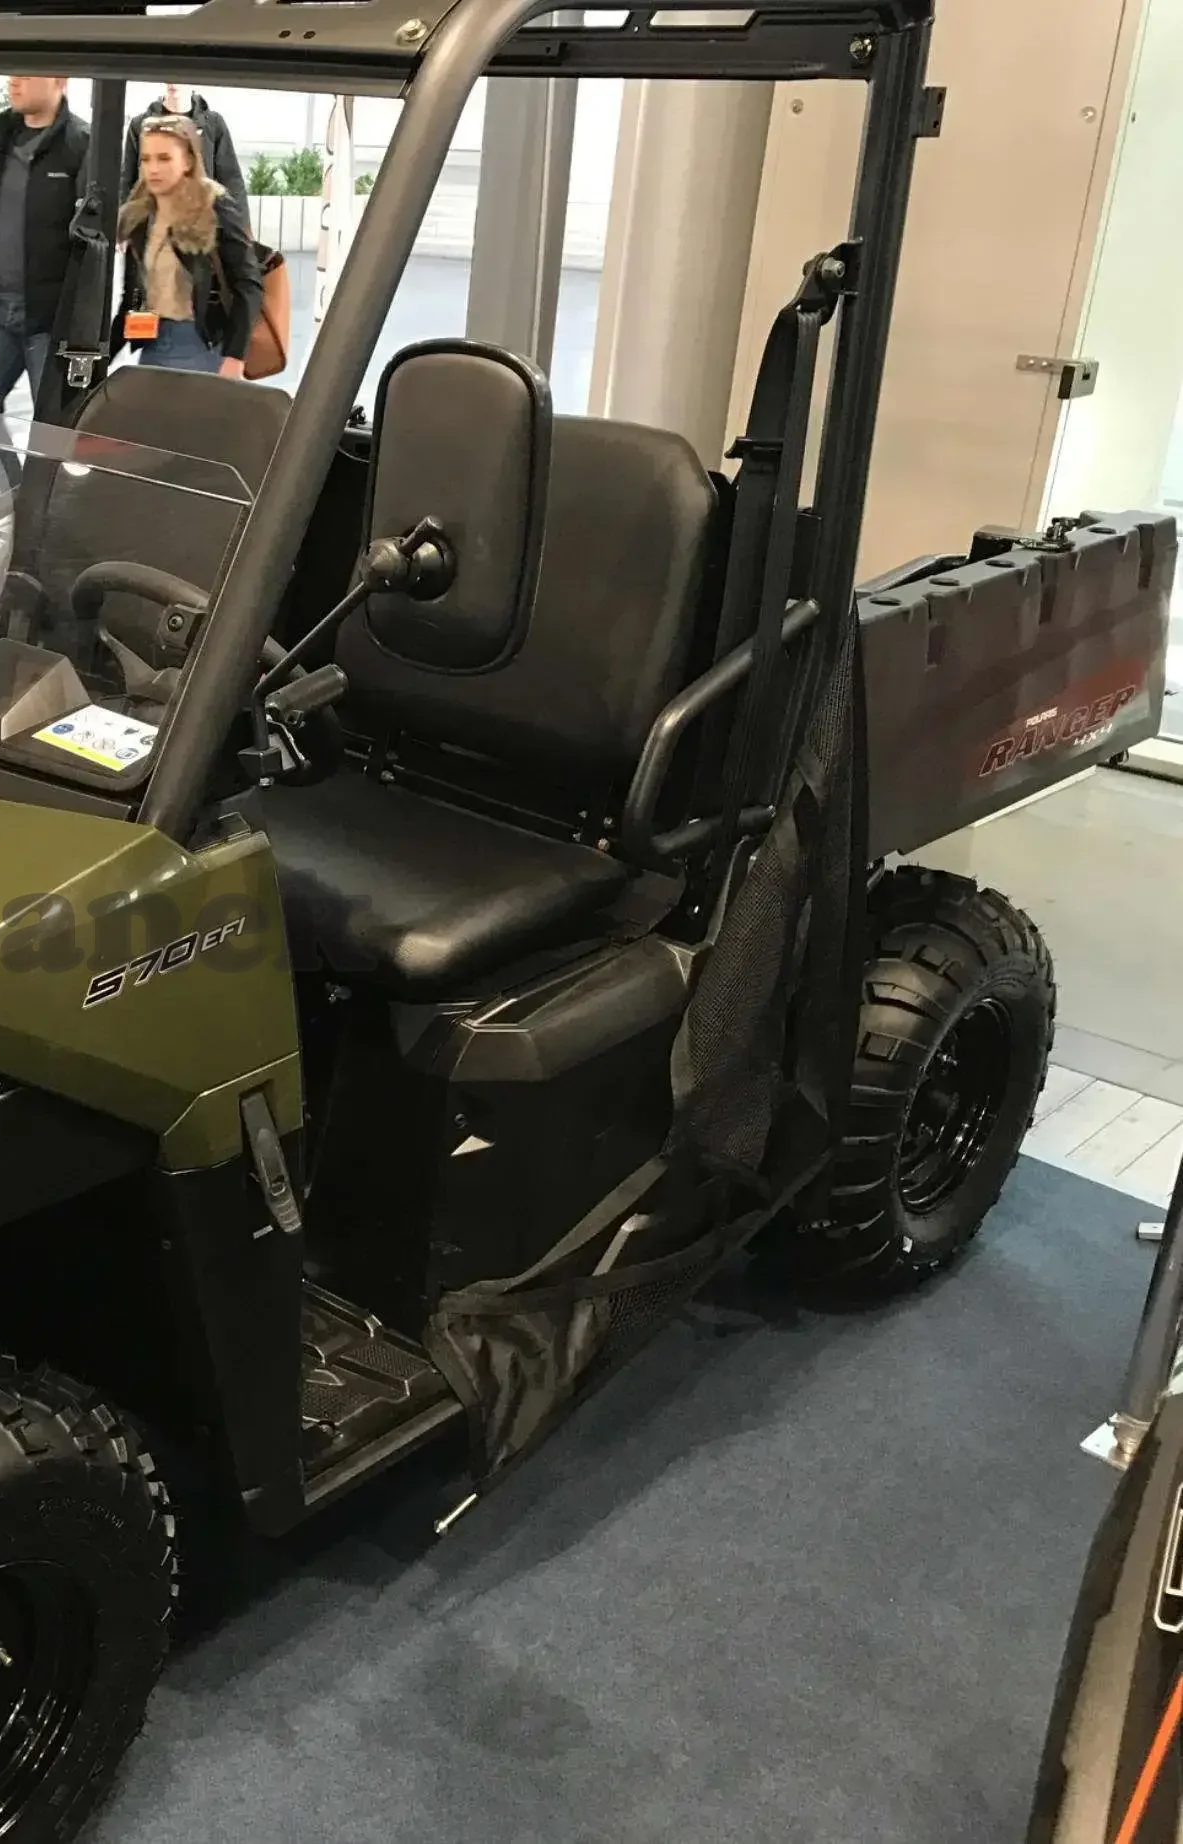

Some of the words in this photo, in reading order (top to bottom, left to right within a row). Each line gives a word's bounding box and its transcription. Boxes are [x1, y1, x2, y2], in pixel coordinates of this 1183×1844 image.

[978, 684, 1137, 778] RANGER
[81, 930, 200, 1010] 570
[200, 915, 247, 953] EFI
